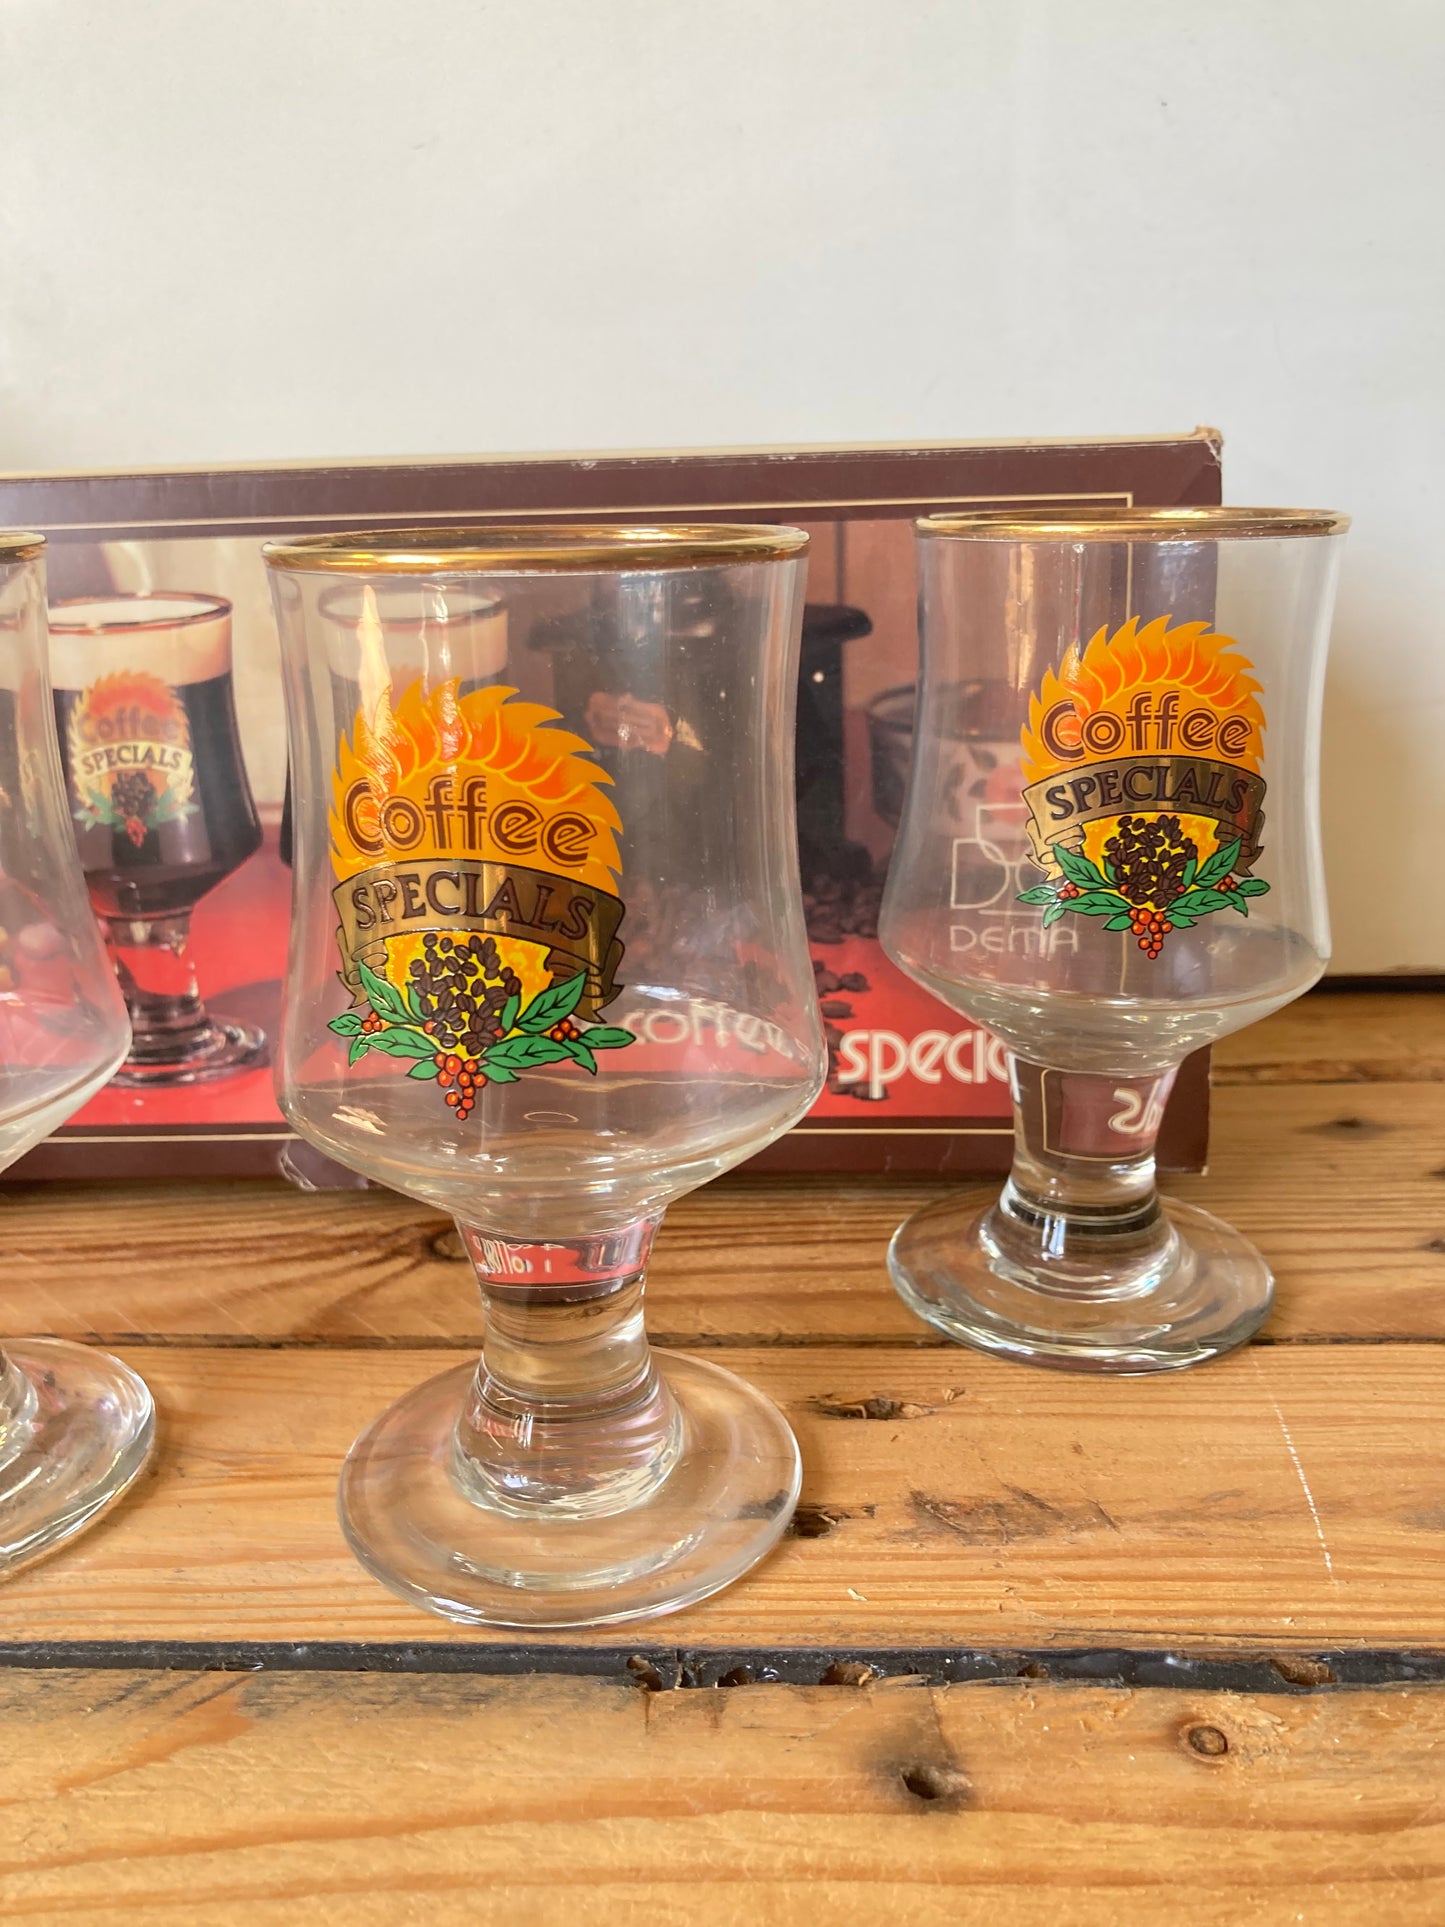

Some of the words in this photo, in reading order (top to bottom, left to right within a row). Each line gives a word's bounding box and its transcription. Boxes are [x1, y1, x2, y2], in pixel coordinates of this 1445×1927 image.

[78, 706, 177, 741] Coffee
[1041, 691, 1252, 762] Coffee
[82, 744, 182, 775] SPECIALS
[1046, 765, 1249, 820] SPECIALS
[345, 774, 597, 867] Coffee
[352, 869, 595, 940] SPECIALS
[838, 1029, 1008, 1099] speci
